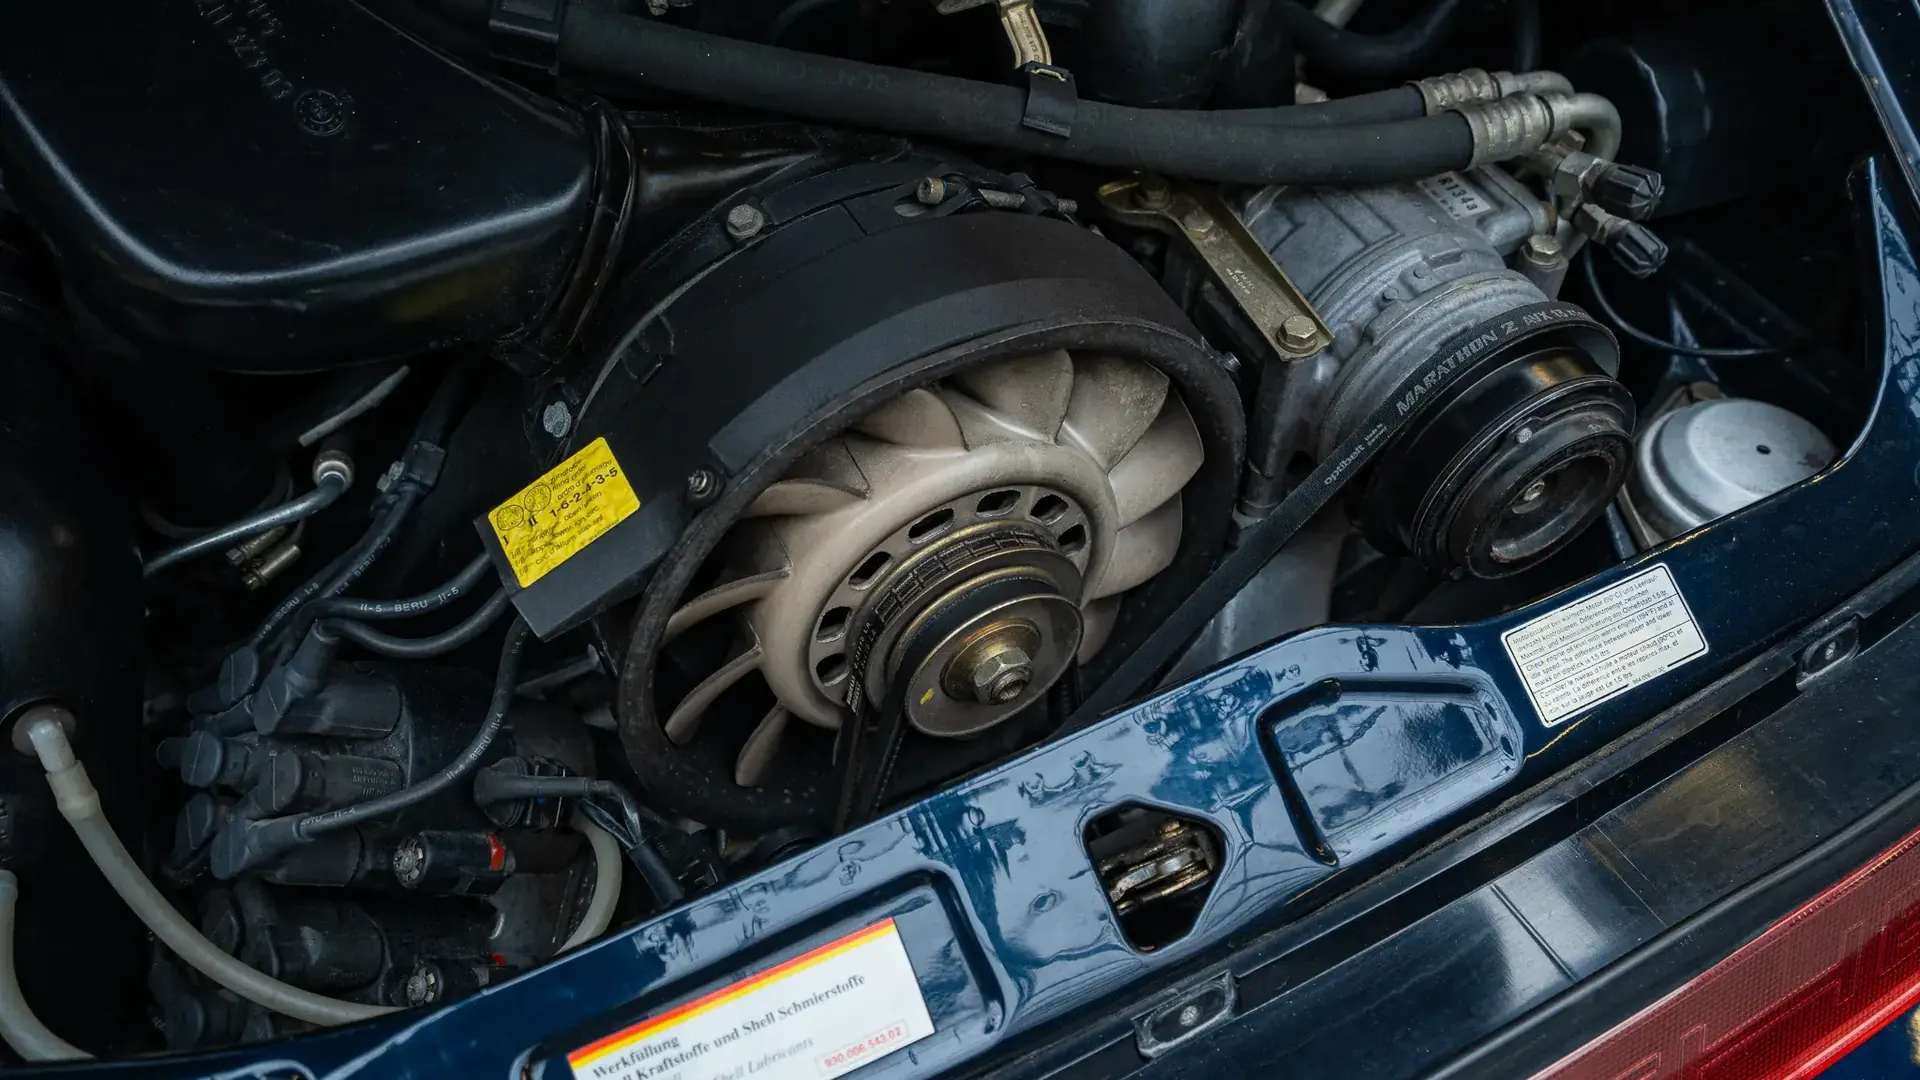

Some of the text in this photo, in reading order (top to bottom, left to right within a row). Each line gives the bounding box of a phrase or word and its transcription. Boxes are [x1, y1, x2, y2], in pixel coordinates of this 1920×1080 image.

[1397, 329, 1498, 416] MARATHON
[1500, 320, 1518, 334] 2
[1522, 310, 1553, 325] AVX
[1324, 444, 1364, 484] optibelt
[550, 467, 617, 516] 1-6-2-4-3-5
[393, 599, 427, 612] BERU
[1525, 659, 1544, 671] Check
[1545, 650, 1564, 662] engine
[1656, 602, 1668, 611] and
[1561, 656, 1573, 664] The
[1574, 643, 1602, 659] difference
[1602, 631, 1627, 645] between
[1627, 623, 1644, 634] upper
[1645, 617, 1656, 626] and
[1656, 610, 1672, 620] lower
[1534, 675, 1552, 686] marks
[1552, 671, 1561, 679] on
[1574, 670, 1593, 682] niveau
[1618, 649, 1638, 661] moteur
[1639, 639, 1657, 651] chaud
[1578, 689, 1594, 701] jauge
[1595, 684, 1604, 692] est
[468, 735, 490, 760] BERU
[635, 974, 866, 1080] Kraftstoffe und Shell Schmierstoffe
[593, 1035, 680, 1079] Werkfüllung
[747, 1037, 815, 1074] Lubricants
